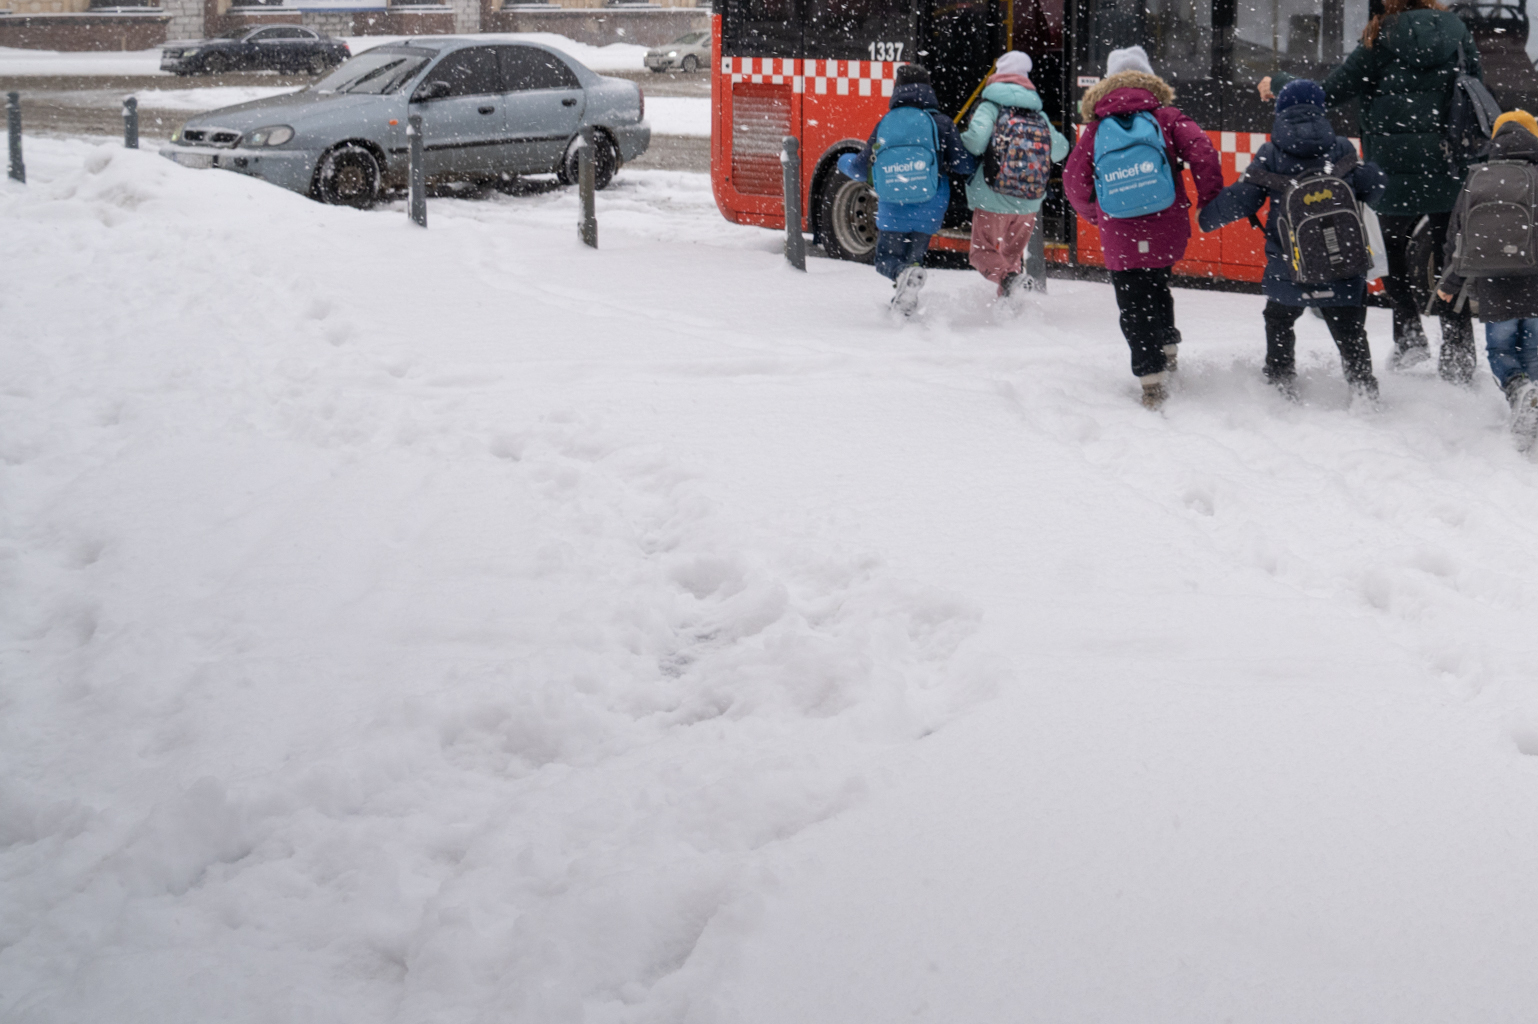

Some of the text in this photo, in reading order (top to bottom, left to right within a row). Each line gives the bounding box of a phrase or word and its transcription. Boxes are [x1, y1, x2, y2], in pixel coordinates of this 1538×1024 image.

[868, 41, 904, 62] 1337
[884, 161, 914, 174] unicef
[1104, 163, 1140, 183] unicef
